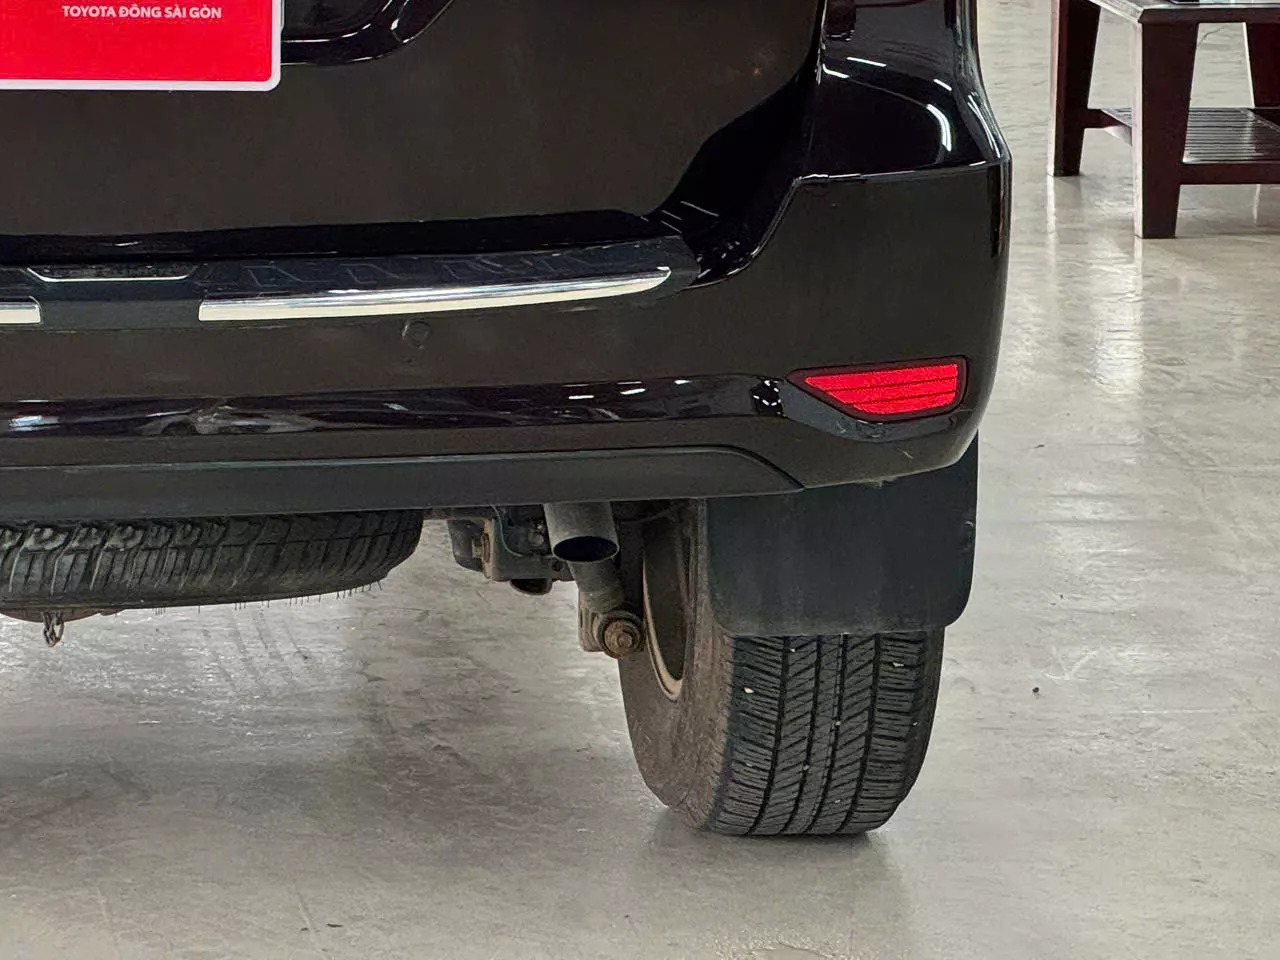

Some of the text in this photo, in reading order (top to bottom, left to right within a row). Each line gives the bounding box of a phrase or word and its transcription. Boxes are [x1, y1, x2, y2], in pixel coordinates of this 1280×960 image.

[62, 4, 222, 19] TOYOTA ĐÔNG SÀI GÒN
